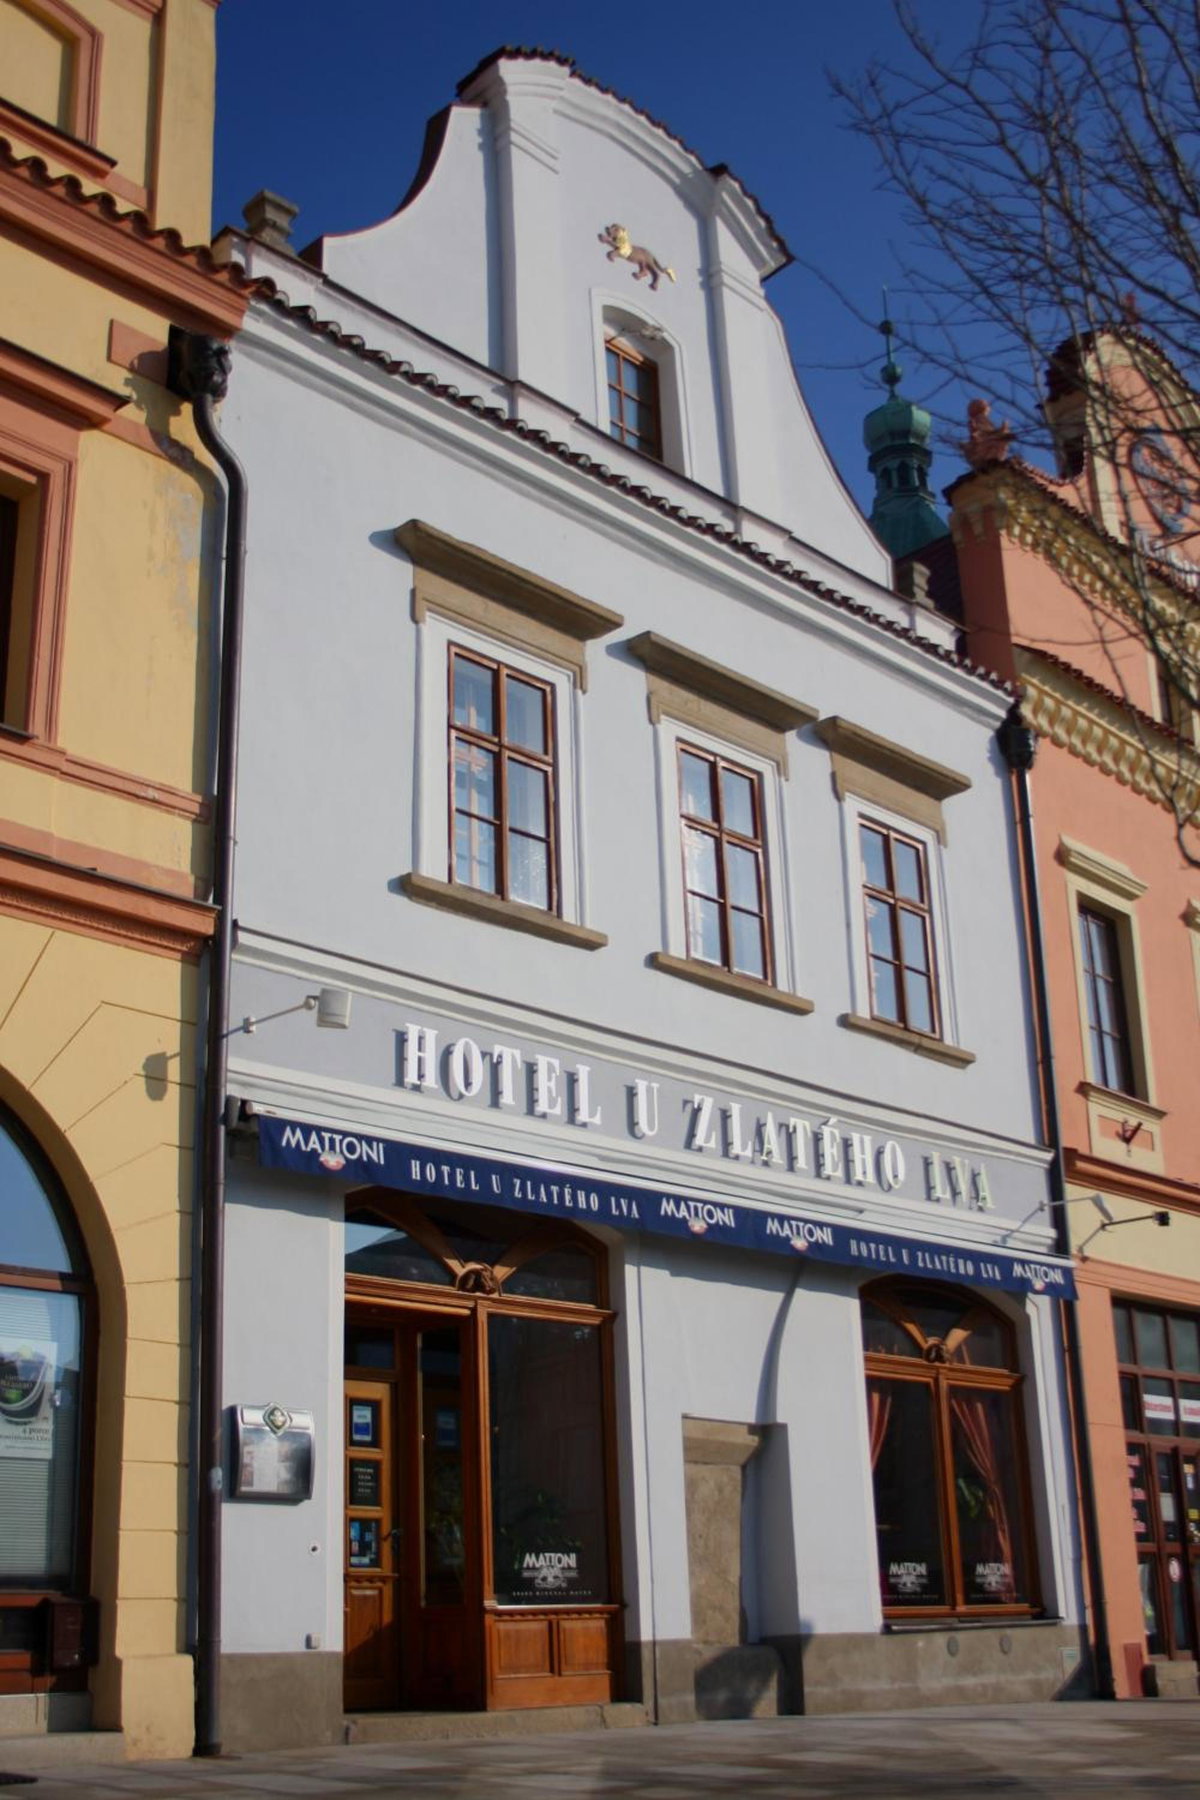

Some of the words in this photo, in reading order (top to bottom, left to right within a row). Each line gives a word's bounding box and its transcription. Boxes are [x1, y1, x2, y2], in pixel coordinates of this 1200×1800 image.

[404, 1023, 601, 1125] HOTEL
[635, 1079, 660, 1136] U
[693, 1094, 905, 1189] ZLATÉHO
[932, 1152, 995, 1209] LVA
[282, 1125, 385, 1165] MATTONI
[411, 1159, 480, 1190] HOTEL
[491, 1174, 501, 1193] U
[513, 1178, 599, 1212] ZLATÉHO
[611, 1196, 640, 1219] LVA
[660, 1197, 735, 1228] MATTONI
[766, 1217, 833, 1246] MATTONI
[849, 1239, 896, 1262] HOTEL
[902, 1249, 911, 1265] U
[917, 1251, 974, 1277] ZLATÉHO
[980, 1262, 1001, 1281] LVA
[1012, 1261, 1065, 1285] MATTONI
[523, 1552, 577, 1568] MATTONI
[889, 1562, 927, 1575] MATTONI
[975, 1562, 1011, 1576] MATTONI
